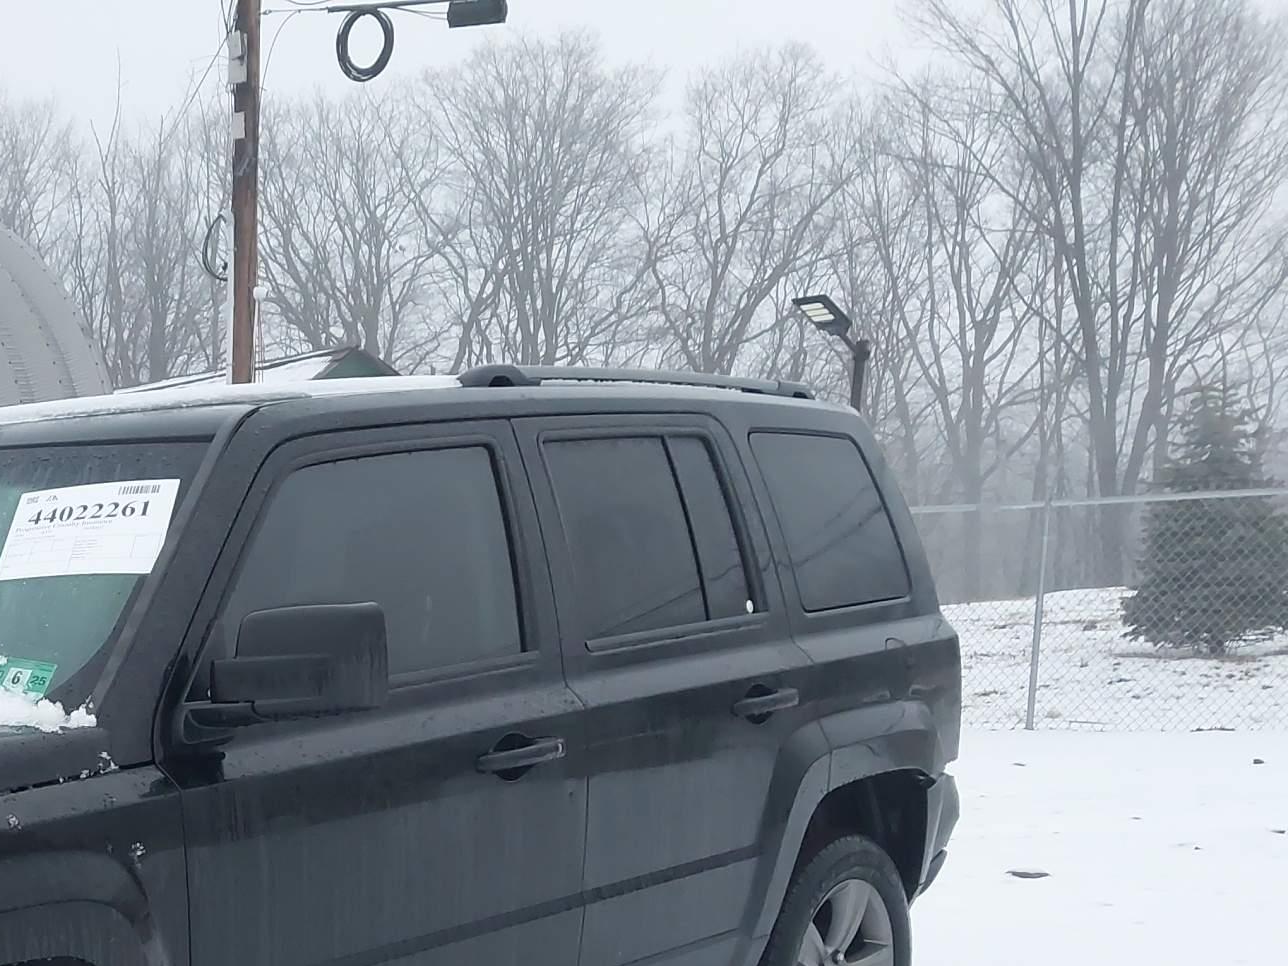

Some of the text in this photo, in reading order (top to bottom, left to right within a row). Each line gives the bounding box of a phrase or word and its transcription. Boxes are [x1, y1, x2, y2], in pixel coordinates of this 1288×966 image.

[28, 499, 150, 525] 44022261
[12, 670, 23, 685] 6
[30, 675, 47, 686] 25
